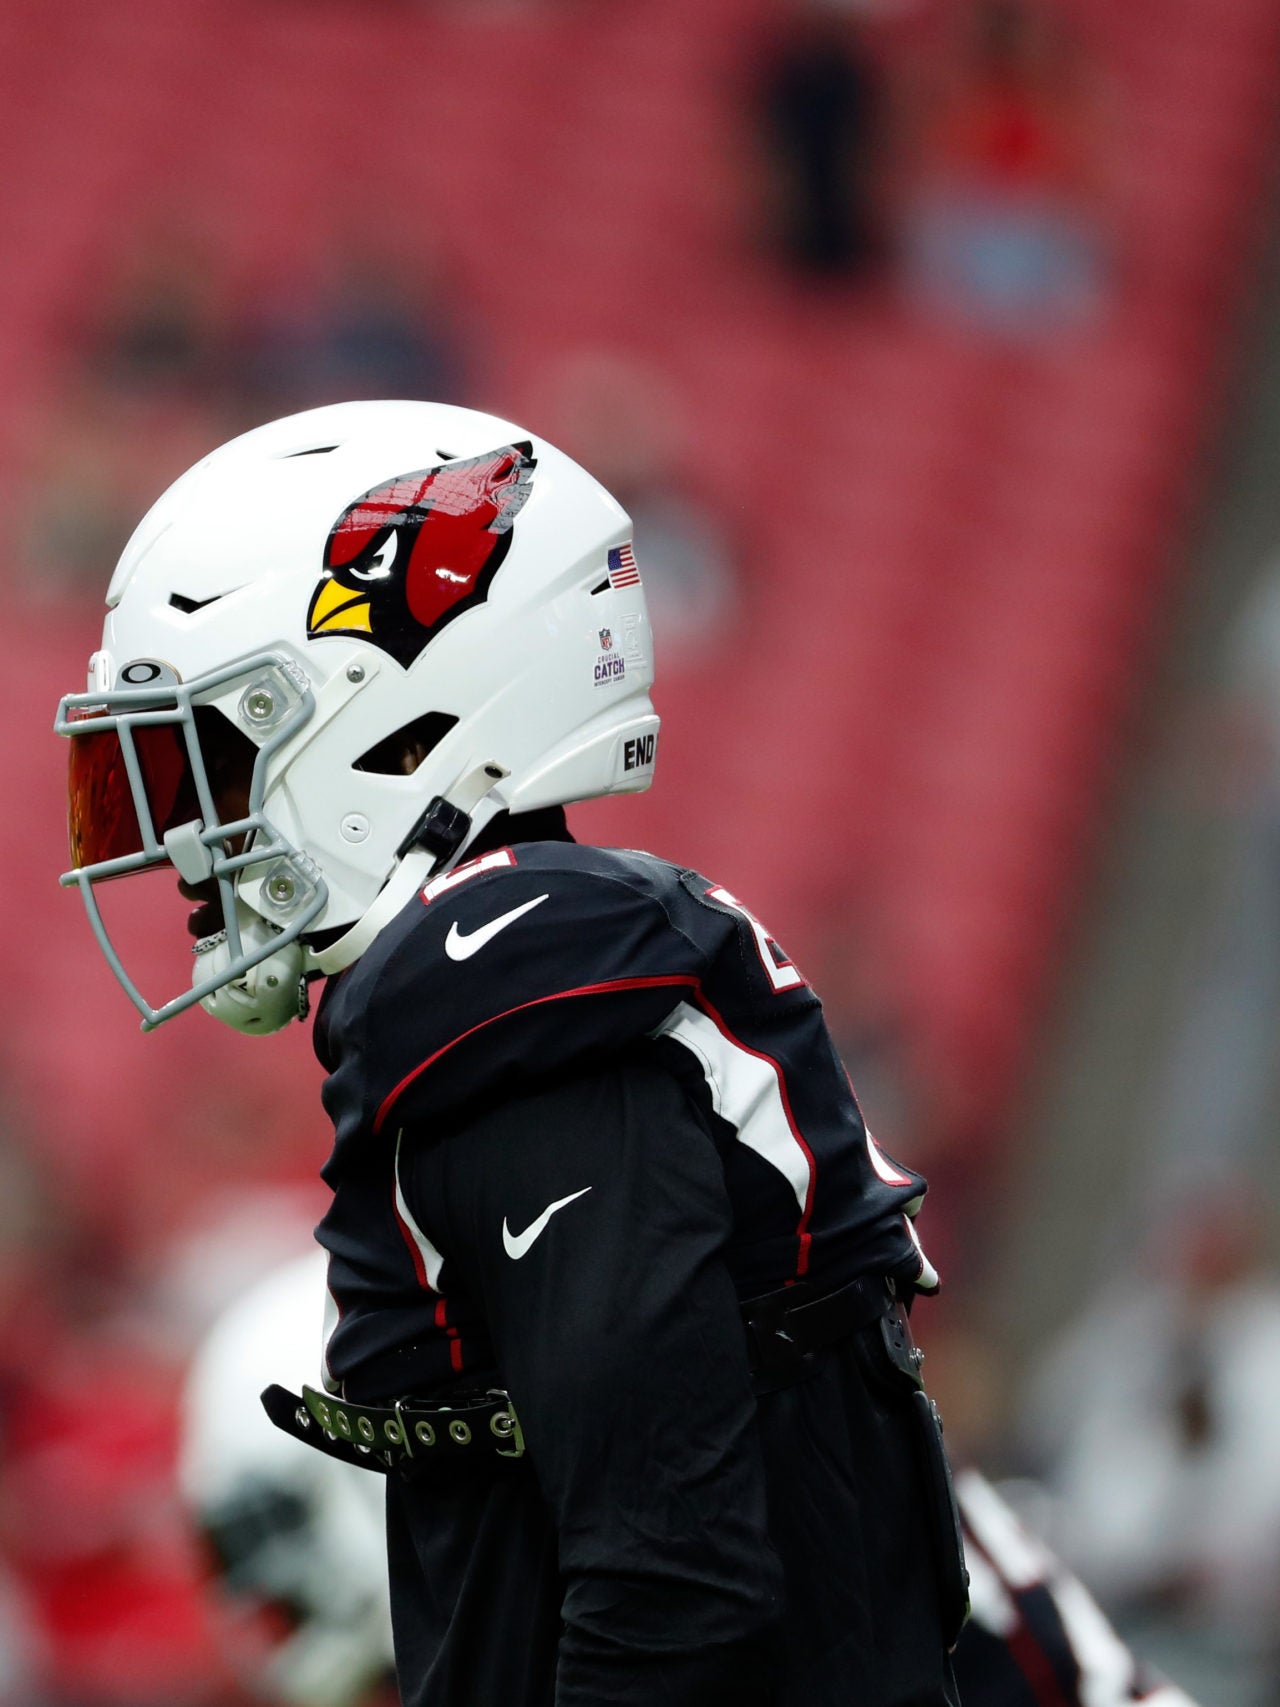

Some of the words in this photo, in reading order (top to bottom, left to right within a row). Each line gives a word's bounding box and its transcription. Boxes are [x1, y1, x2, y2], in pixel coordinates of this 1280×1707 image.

[594, 657, 625, 680] CATCH
[598, 652, 619, 664] CRUCIAL
[624, 734, 655, 772] END
